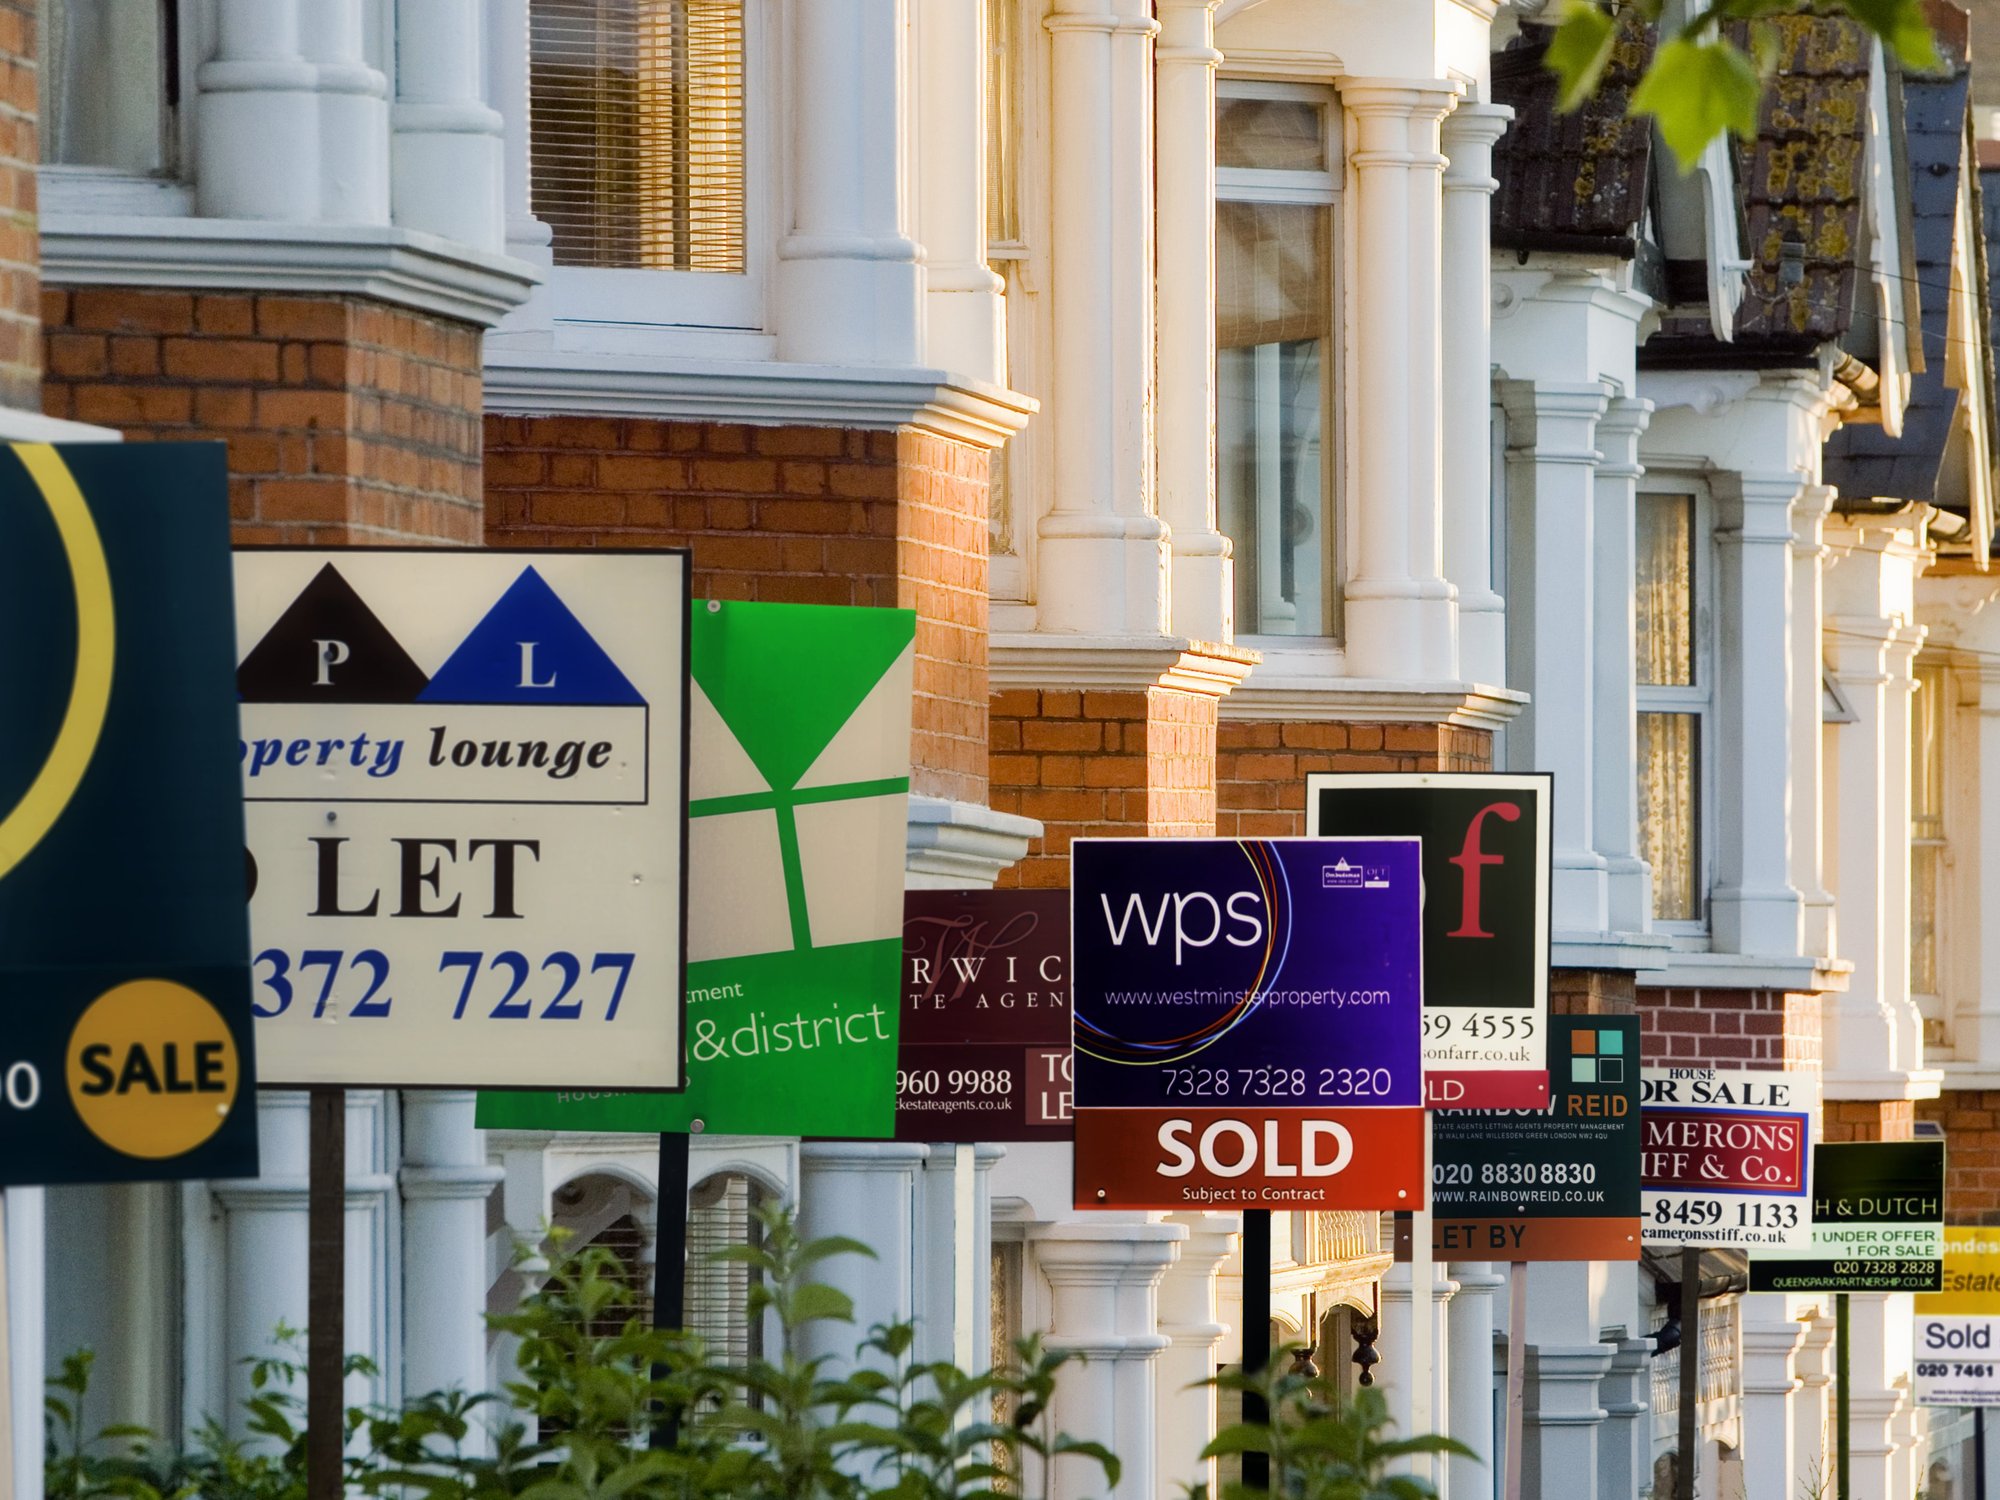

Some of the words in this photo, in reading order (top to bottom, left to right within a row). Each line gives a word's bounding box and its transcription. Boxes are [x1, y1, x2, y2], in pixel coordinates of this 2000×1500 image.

[312, 639, 350, 685] P
[515, 642, 557, 687] L
[238, 732, 405, 778] perty
[429, 726, 613, 779] lounge
[306, 837, 541, 919] LET
[1446, 802, 1521, 938] f
[1101, 890, 1263, 966] wps
[251, 949, 392, 1019] 372
[439, 951, 636, 1021] 7227
[1105, 987, 1391, 1009] www.westminsterproperty.com
[1462, 1012, 1534, 1040] 4555
[80, 1042, 227, 1096] SALE
[896, 1070, 940, 1095] 960
[948, 1069, 1012, 1095] 9988
[1162, 1068, 1230, 1096] 7328
[1238, 1068, 1307, 1096] 7328
[1319, 1068, 1392, 1096] 2320
[1669, 1068, 1716, 1081] HOUSE
[0, 1061, 40, 1108] 0
[1423, 1080, 1465, 1101] LD
[1691, 1081, 1791, 1107] SALE
[1567, 1094, 1628, 1117] REID
[1580, 1123, 1625, 1131] MANAGEMENT
[1156, 1118, 1354, 1178] SOLD
[1432, 1164, 1473, 1185] 020
[1481, 1163, 1537, 1185] 8830
[1540, 1163, 1596, 1184] 8830
[1700, 1154, 1730, 1180] &
[1740, 1155, 1793, 1183] Co.
[1183, 1187, 1236, 1204] Subject
[1241, 1188, 1257, 1201] to
[1261, 1187, 1326, 1201] Contract
[1432, 1190, 1605, 1203] WWW.RAINBOWREID.CO.UK
[1836, 1199, 1854, 1216] &
[1859, 1197, 1937, 1216] DUTCH
[1736, 1202, 1799, 1229] 1133
[1489, 1225, 1526, 1249] BY
[1822, 1231, 1878, 1243] UNDER
[1846, 1246, 1852, 1257] 1
[1858, 1245, 1889, 1257] FOR
[1895, 1245, 1935, 1257] SALE
[1833, 1261, 1860, 1274] 020
[1863, 1261, 1897, 1274] 7328
[1901, 1261, 1935, 1274] 2828
[1772, 1277, 1935, 1289] QUEENSPARKPARTNERSHIP.CO.UK
[1926, 1322, 1991, 1349] Sold
[1916, 1363, 1949, 1378] 020
[1953, 1363, 1994, 1378] 7461
